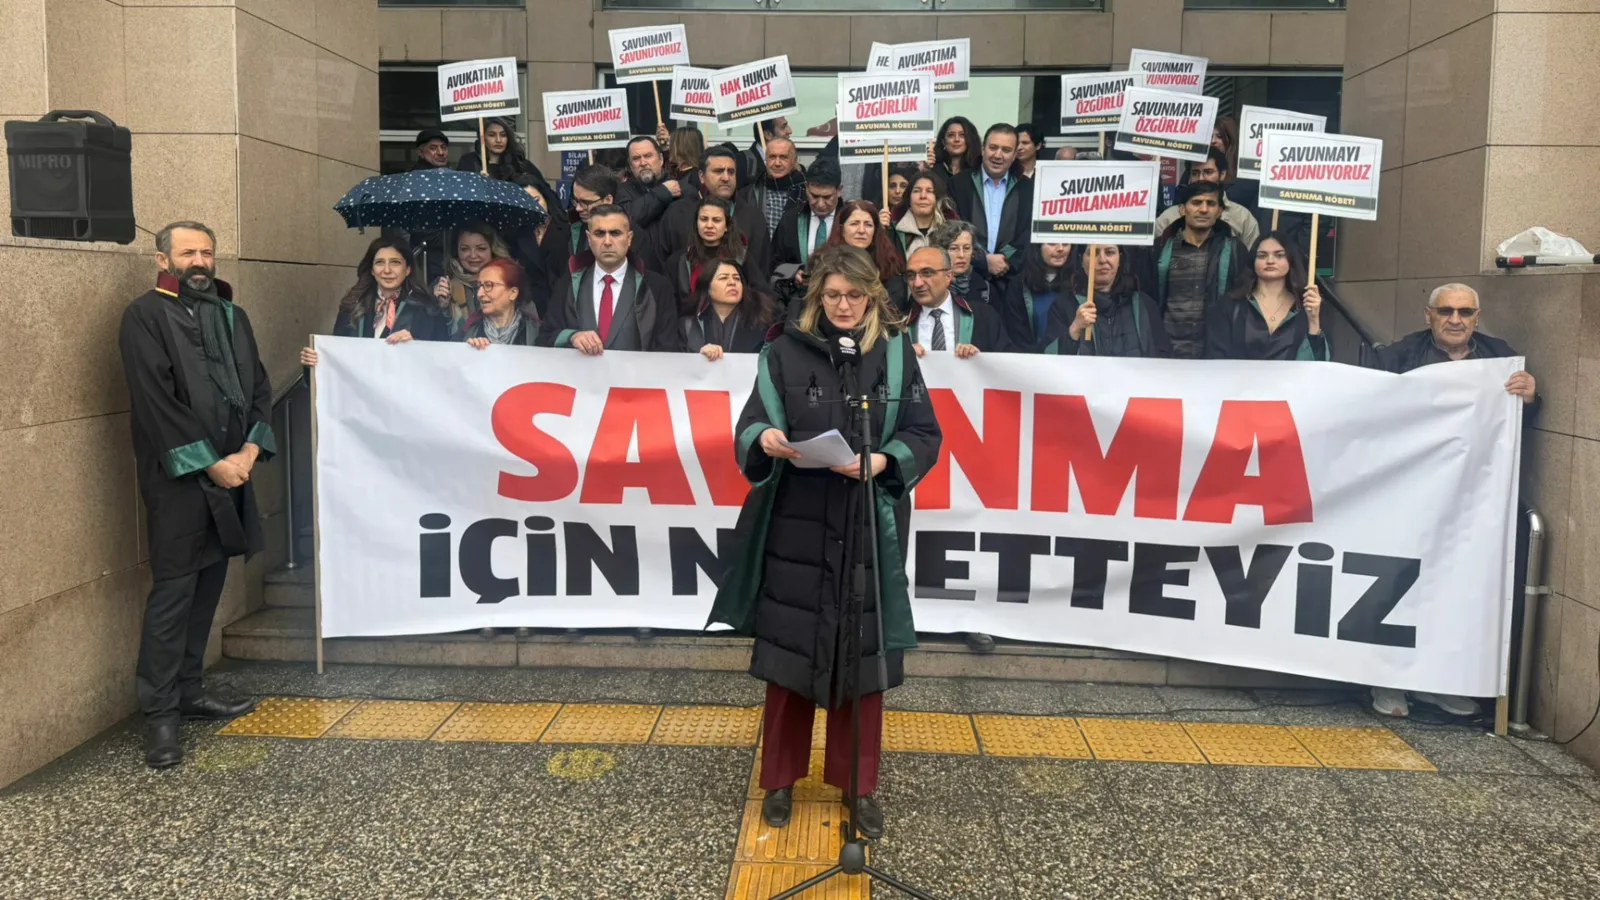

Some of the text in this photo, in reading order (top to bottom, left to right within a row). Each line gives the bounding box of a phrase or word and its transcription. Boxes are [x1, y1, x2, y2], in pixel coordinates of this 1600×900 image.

[622, 31, 672, 51] SAVUNMAYI
[619, 42, 682, 64] SAVUNUYORUZ
[898, 46, 957, 69] AVUKATIMA
[447, 65, 504, 89] AVUKATIMA
[1142, 62, 1194, 73] SAVUNMAYI
[720, 64, 778, 96] HAK HUKUK
[1070, 78, 1134, 101] SAVUNMAYA
[1146, 74, 1200, 86] VUNUYORUZ
[453, 80, 504, 102] DOKUNMA
[685, 92, 713, 104] DOKU
[736, 82, 772, 107] ADALET
[848, 79, 920, 103] SAVUNMAYA
[453, 104, 482, 112] SAVUNMA
[556, 96, 611, 117] SAVUNMAYI
[730, 108, 760, 119] SAVUNMA
[856, 95, 918, 119] ÖZGÜRLÜK
[1076, 92, 1124, 114] ÖZGÜRLÜ
[1131, 101, 1203, 117] SAVUNMAYA
[552, 107, 622, 130] SAVUNUYORUZ
[892, 121, 917, 129] NÖBETİ
[1135, 117, 1199, 133] ÖZGÜRLÜK
[1132, 136, 1192, 150] SAVUNMA NÖBETİ
[18, 154, 72, 169] MIPRO
[1279, 146, 1361, 162] SAVUNMAYI
[1270, 164, 1371, 181] SAVUNUYORUZ
[1060, 174, 1124, 196] SAVUNMA
[1041, 190, 1148, 216] TUTUKLANAMAZ
[1280, 190, 1355, 206] SAVUNMA NÖBETİ
[1053, 222, 1132, 232] SAVUNMA NÖBETİ
[491, 382, 1312, 526] SAVNMA
[669, 527, 1422, 649] NETTEYİZ
